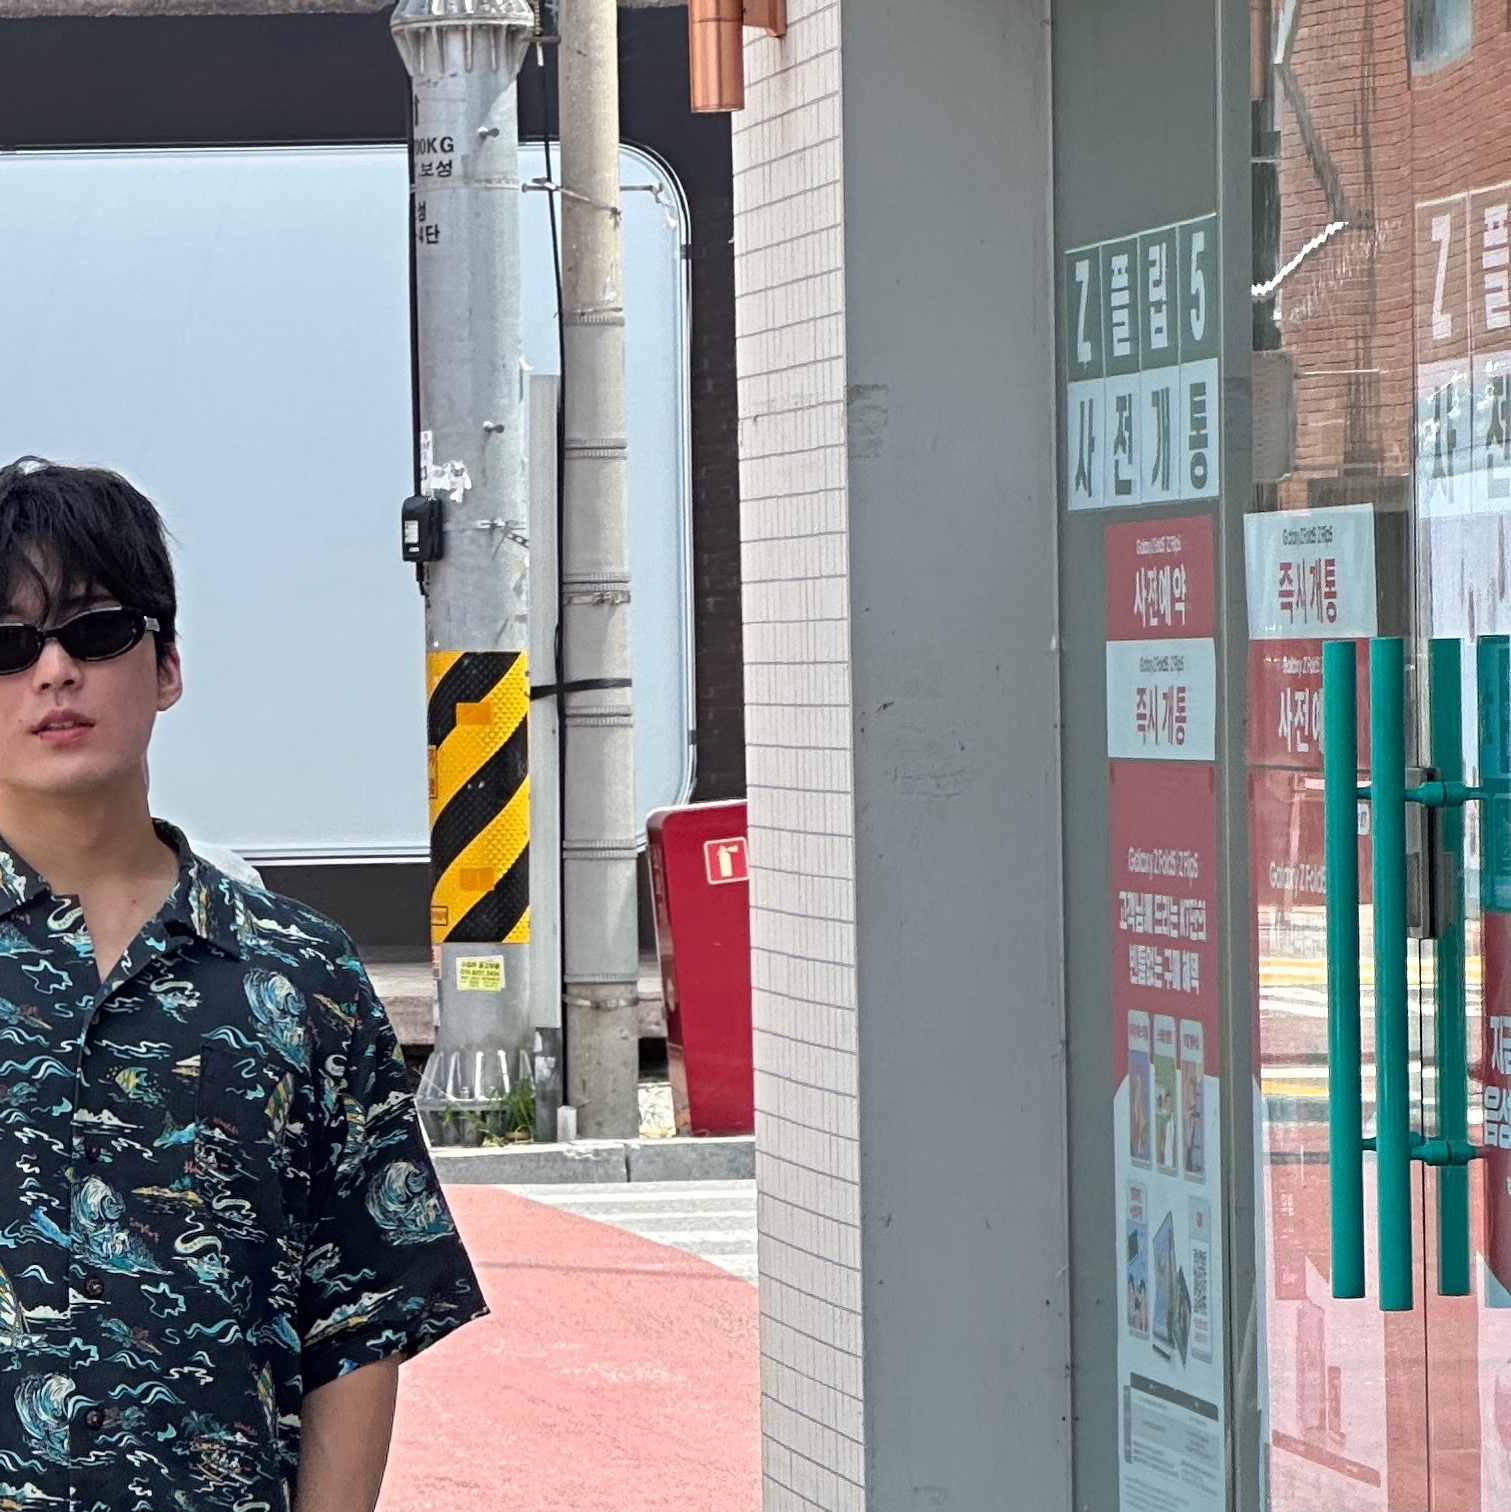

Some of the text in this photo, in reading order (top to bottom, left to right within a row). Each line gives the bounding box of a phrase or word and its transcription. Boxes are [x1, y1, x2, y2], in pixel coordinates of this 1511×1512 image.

[1075, 231, 1207, 364] Z플립5
[1075, 380, 1209, 498] 사전개통
[1134, 563, 1187, 628] 사전예약
[1278, 687, 1325, 753] 사전예
